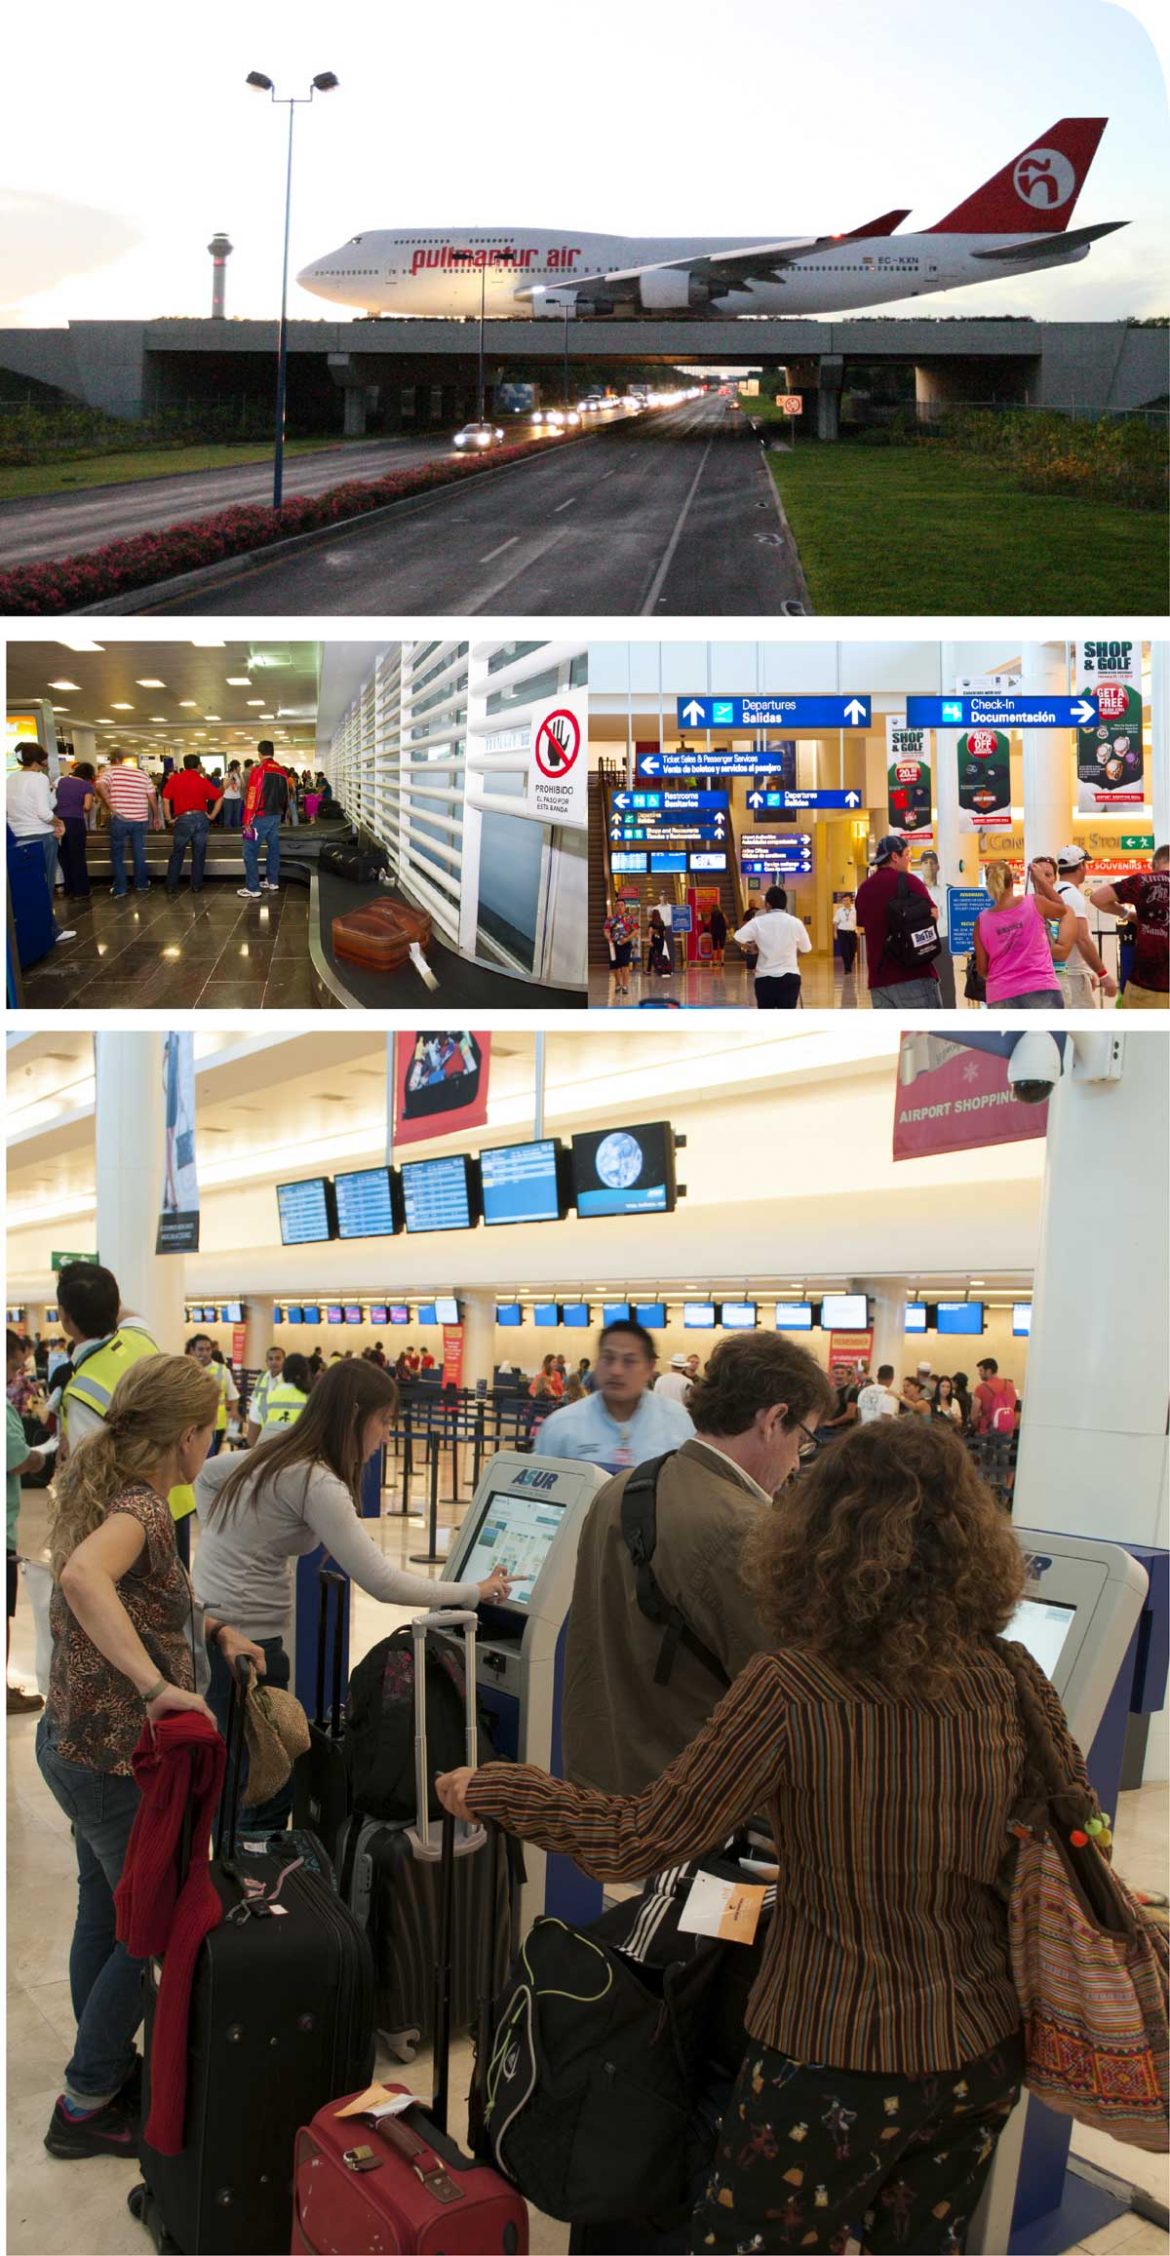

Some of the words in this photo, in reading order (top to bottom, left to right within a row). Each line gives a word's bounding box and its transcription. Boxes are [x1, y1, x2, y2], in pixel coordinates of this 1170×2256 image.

[412, 246, 539, 276] pullmantur
[546, 246, 581, 267] air
[1084, 641, 1132, 657] SHOP
[1084, 660, 1094, 670] &
[1097, 657, 1131, 670] GOLF
[1097, 688, 1115, 698] GET
[1117, 688, 1125, 698] A
[742, 699, 796, 712] Departures
[970, 699, 1015, 710] Check-In
[1099, 698, 1123, 707] FREE
[742, 711, 782, 723] Salidas
[970, 711, 1056, 723] Documentación
[892, 732, 923, 744] SHOP
[974, 739, 992, 749] OFF
[901, 742, 923, 752] GOLF
[535, 784, 574, 795] PROHIBIDO
[1095, 862, 1142, 871] SOUVENIRS
[899, 1101, 951, 1124] AIRPORT
[955, 1090, 1017, 1114] SHOPPING
[511, 1468, 559, 1490] ASUR
